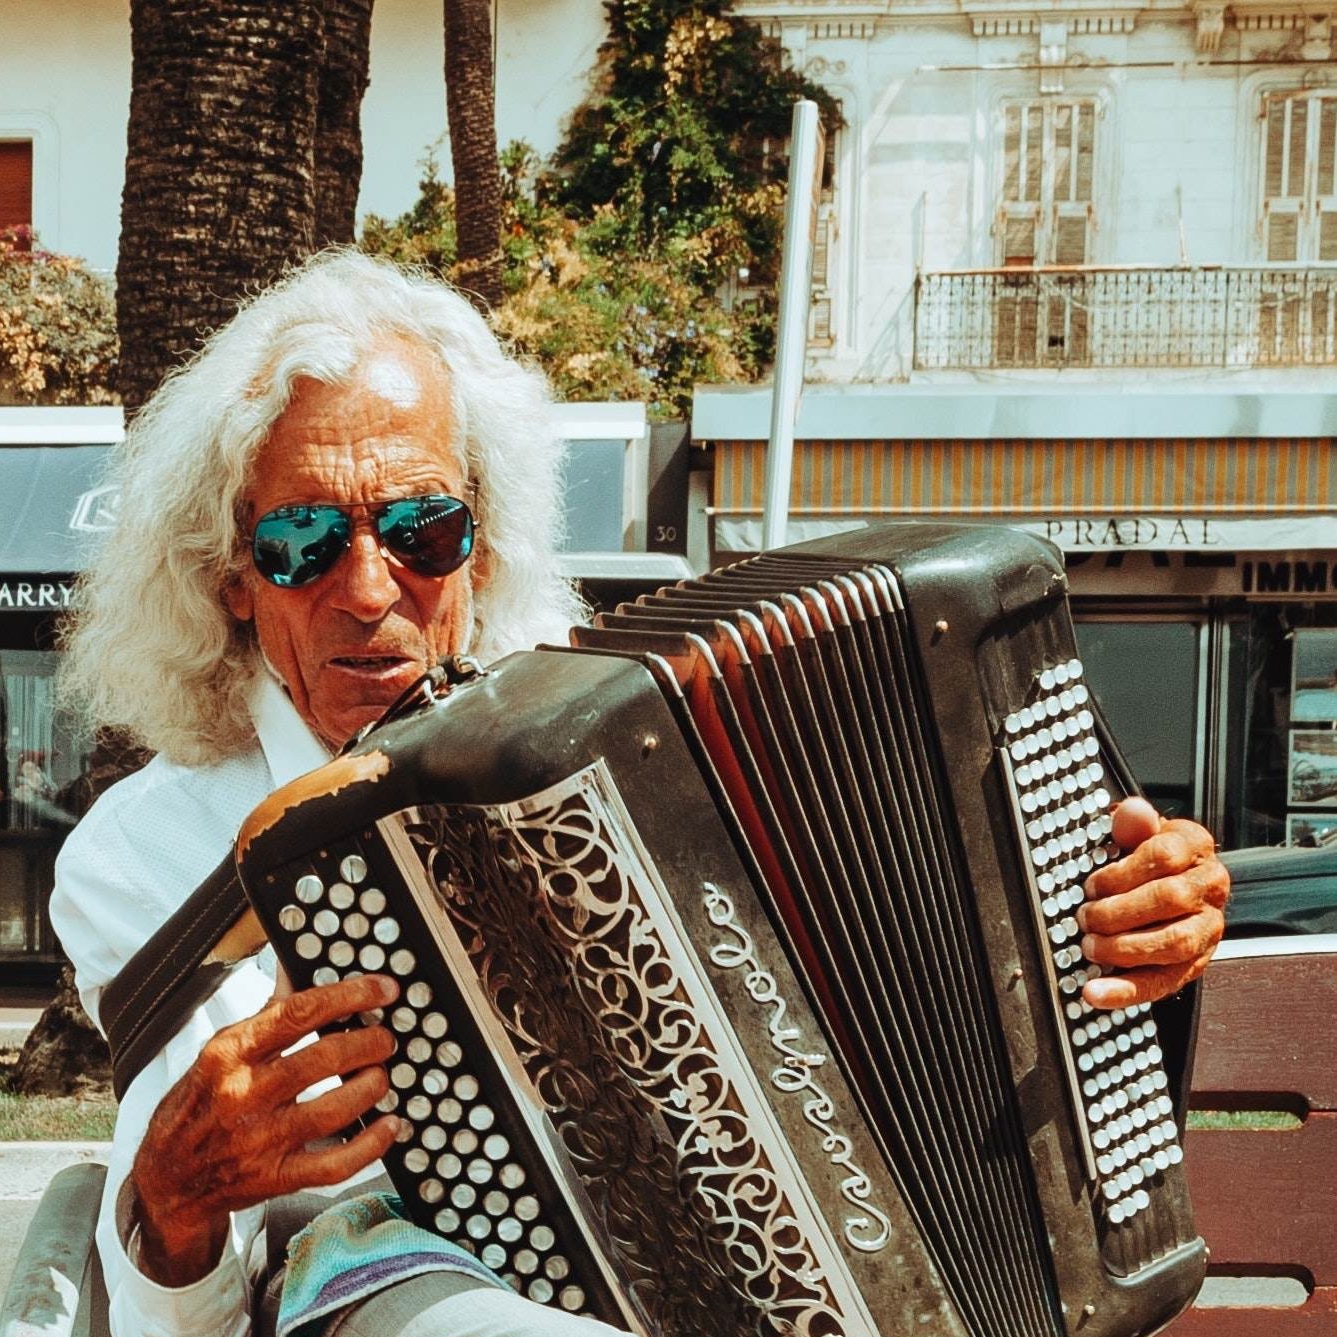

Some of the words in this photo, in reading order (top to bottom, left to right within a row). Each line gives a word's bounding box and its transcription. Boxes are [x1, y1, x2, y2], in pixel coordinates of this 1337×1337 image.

[654, 525, 677, 542] 30
[1045, 519, 1219, 545] PRADAL
[1242, 560, 1337, 592] IMM
